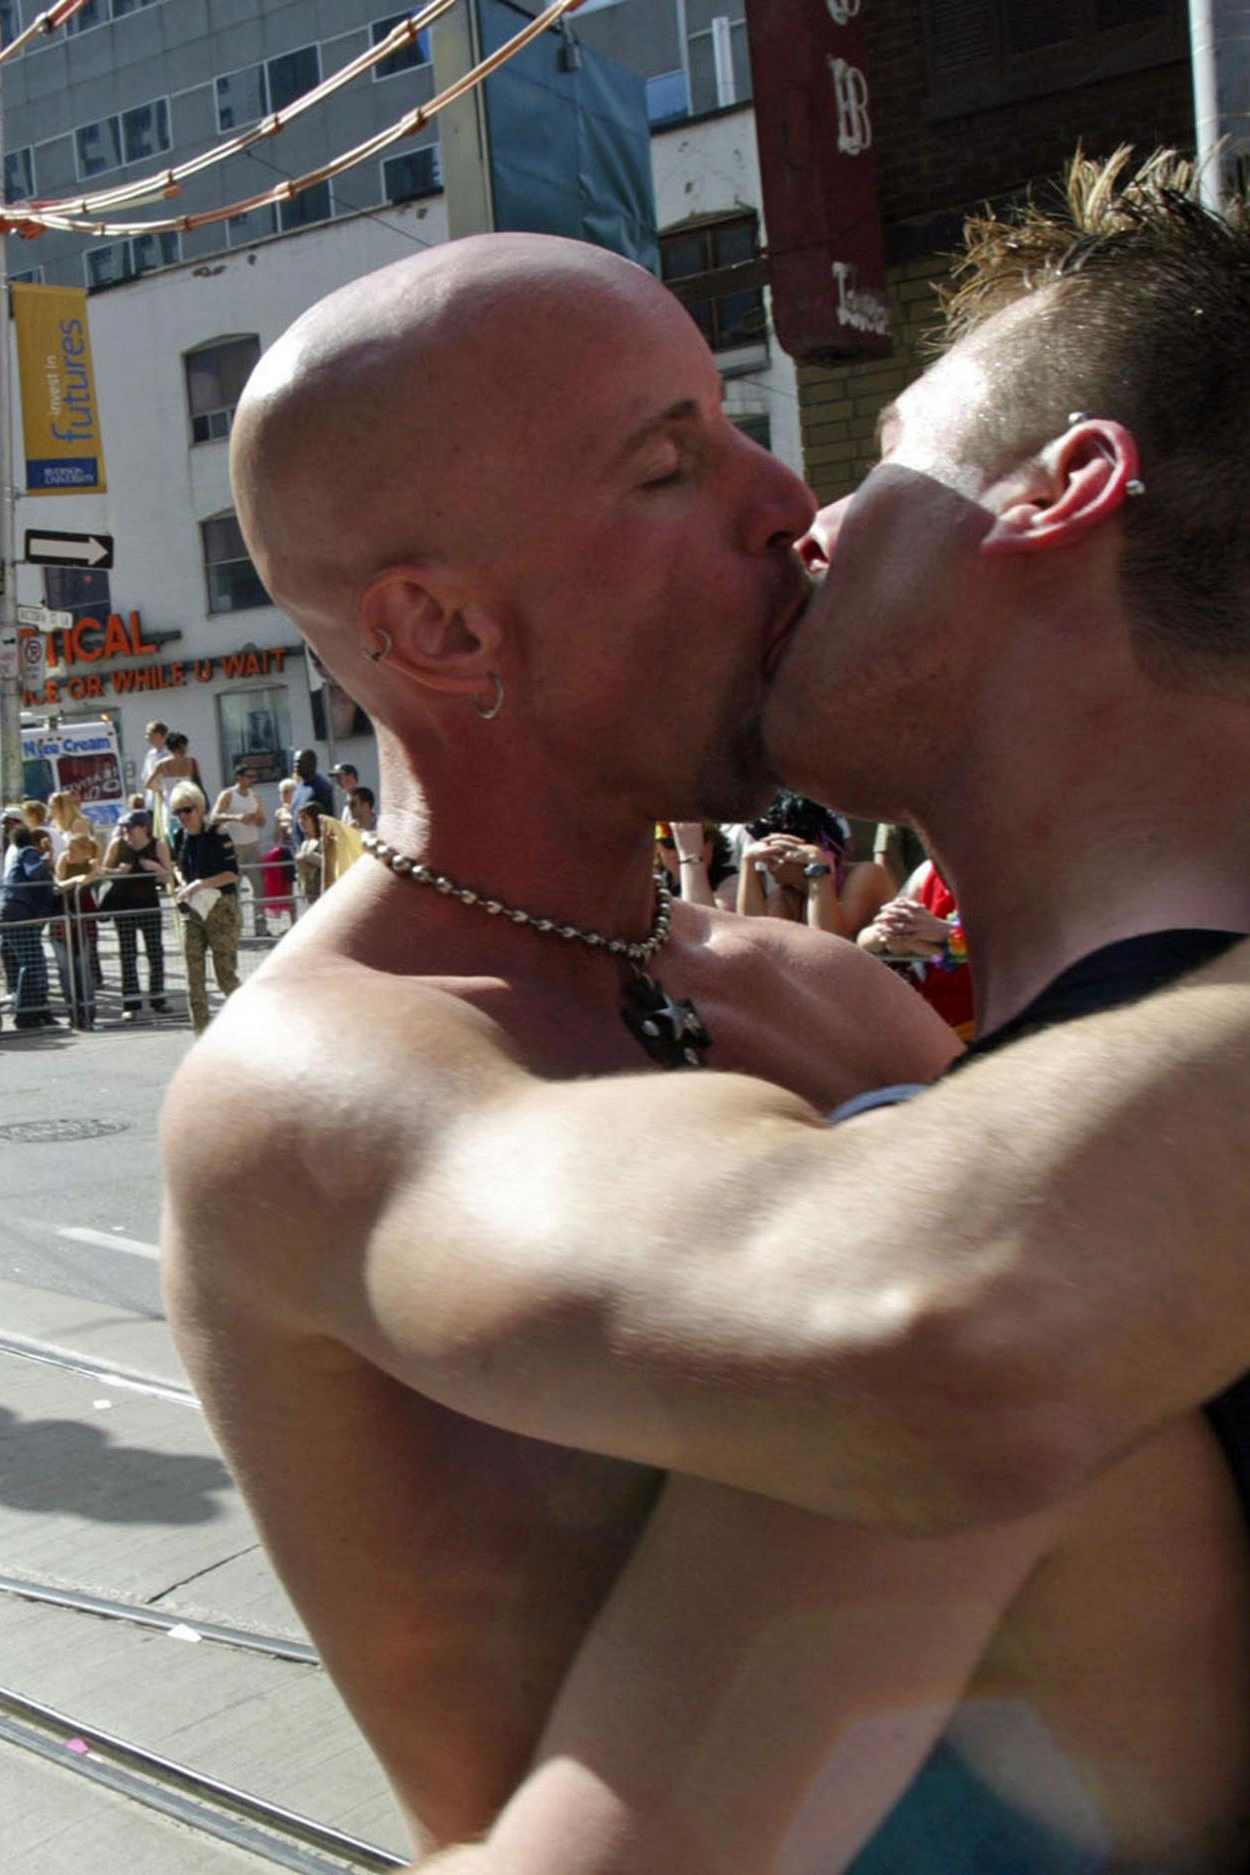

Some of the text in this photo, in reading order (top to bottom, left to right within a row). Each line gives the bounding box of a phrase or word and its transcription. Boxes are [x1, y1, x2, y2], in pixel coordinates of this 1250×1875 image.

[44, 354, 61, 417] invest in
[51, 318, 95, 443] futures
[67, 673, 103, 700] OR
[111, 662, 187, 694] WHILE
[193, 661, 213, 684] U
[221, 647, 287, 679] WAIT
[63, 738, 111, 752] Cream
